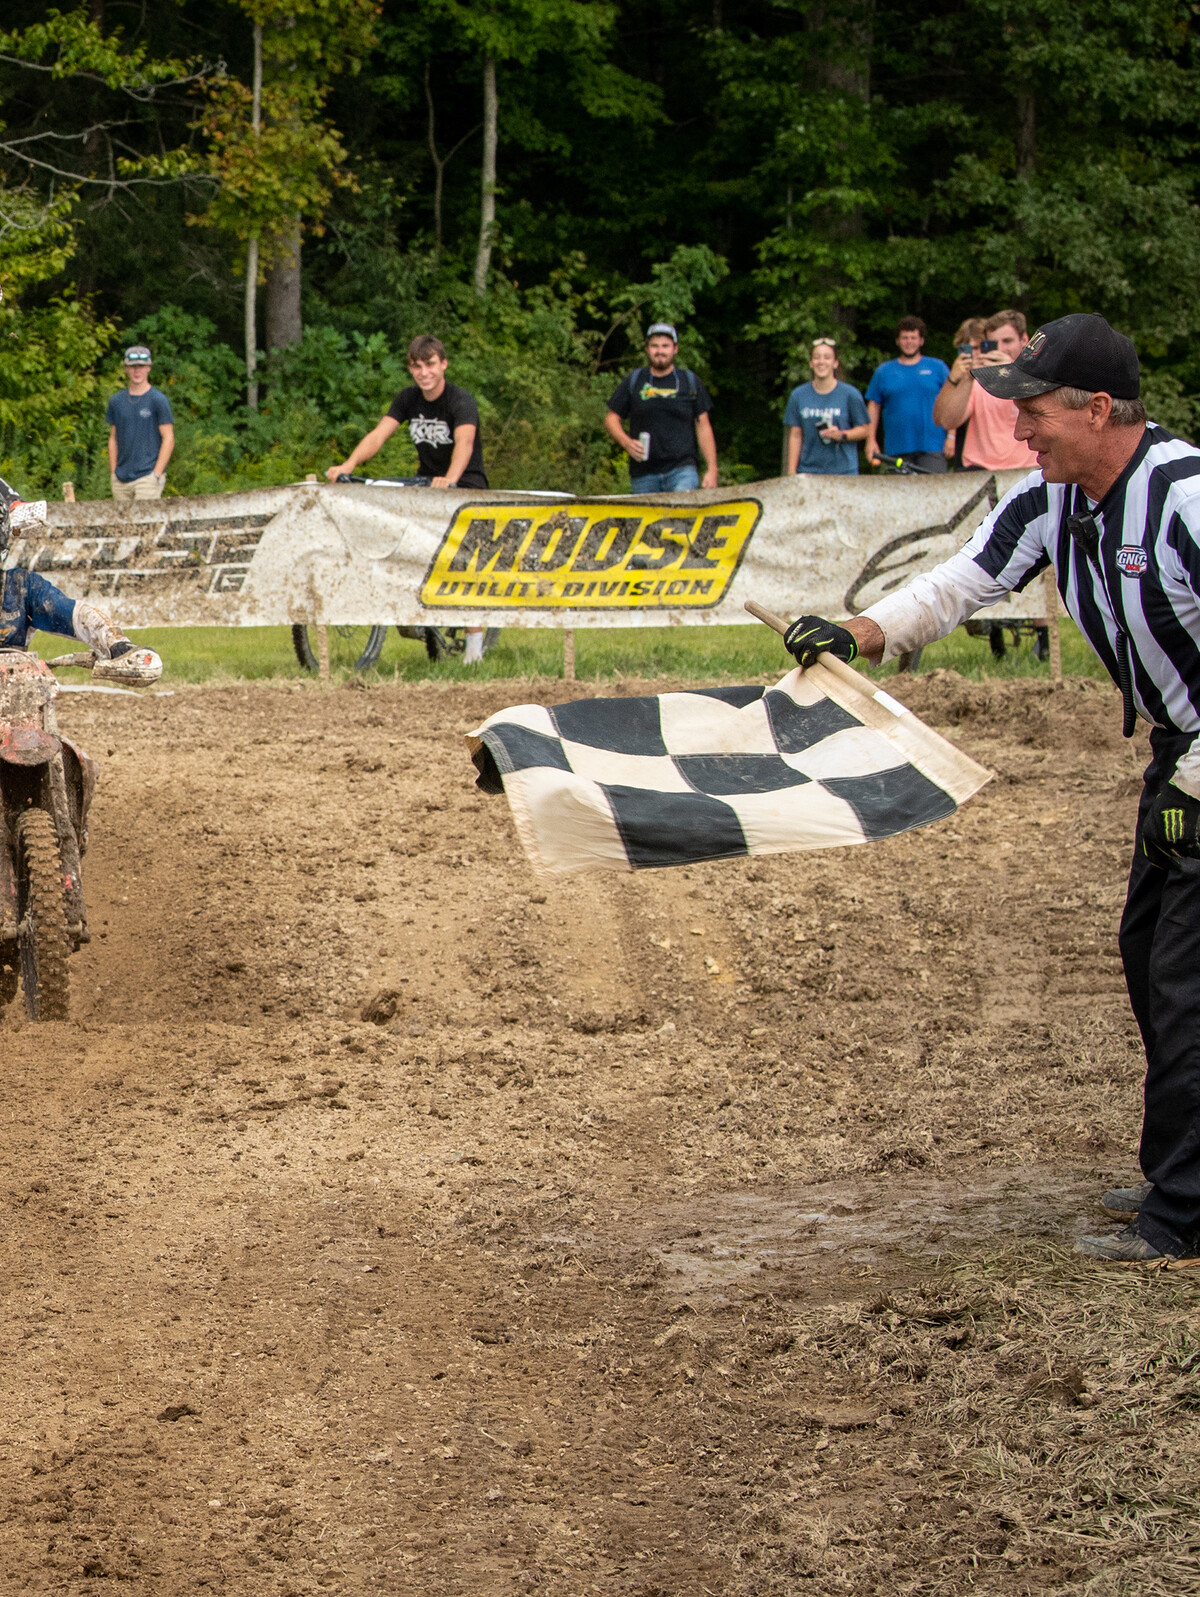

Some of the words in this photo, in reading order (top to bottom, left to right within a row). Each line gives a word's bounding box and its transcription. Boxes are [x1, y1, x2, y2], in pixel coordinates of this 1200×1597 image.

[448, 514, 742, 573] MOOSE
[1118, 552, 1147, 567] GNCC
[436, 580, 554, 597] UTILITY
[561, 578, 716, 598] DIVISION
